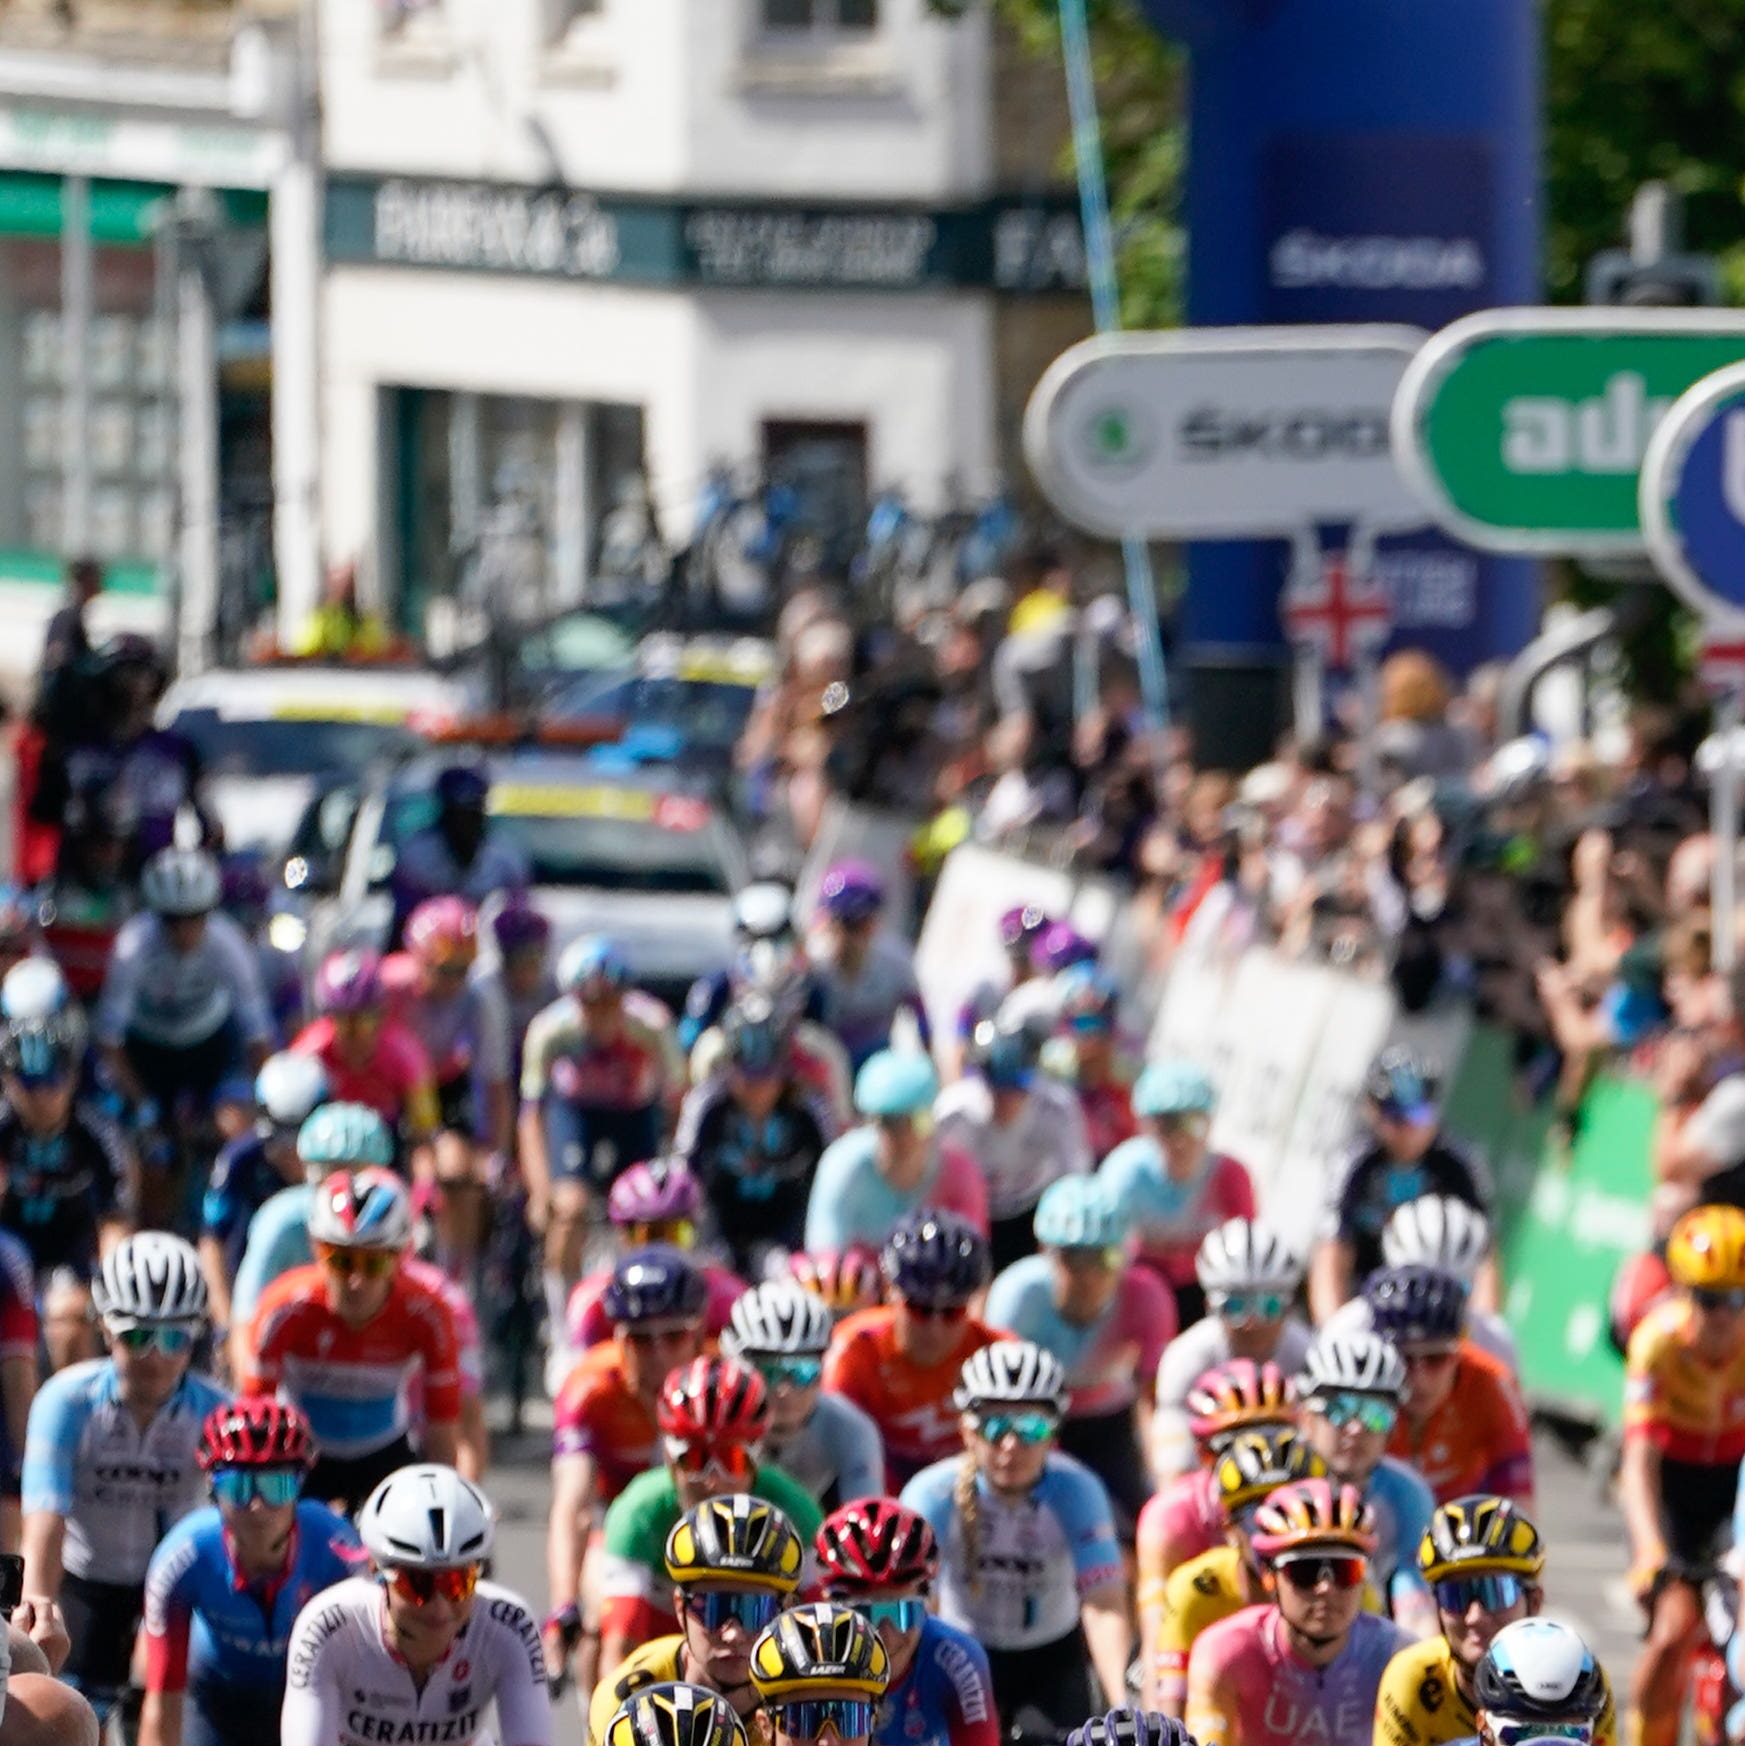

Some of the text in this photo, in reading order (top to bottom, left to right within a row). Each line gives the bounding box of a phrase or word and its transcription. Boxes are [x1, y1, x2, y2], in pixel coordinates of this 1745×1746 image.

[1180, 408, 1398, 465] ŠKOD
[291, 1603, 347, 1690] CERATIZIT
[490, 1599, 546, 1685] CERATIZIT
[810, 1663, 846, 1676] LAZER
[347, 1709, 479, 1744] CERATIZIT
[1263, 1696, 1362, 1741] UAE
